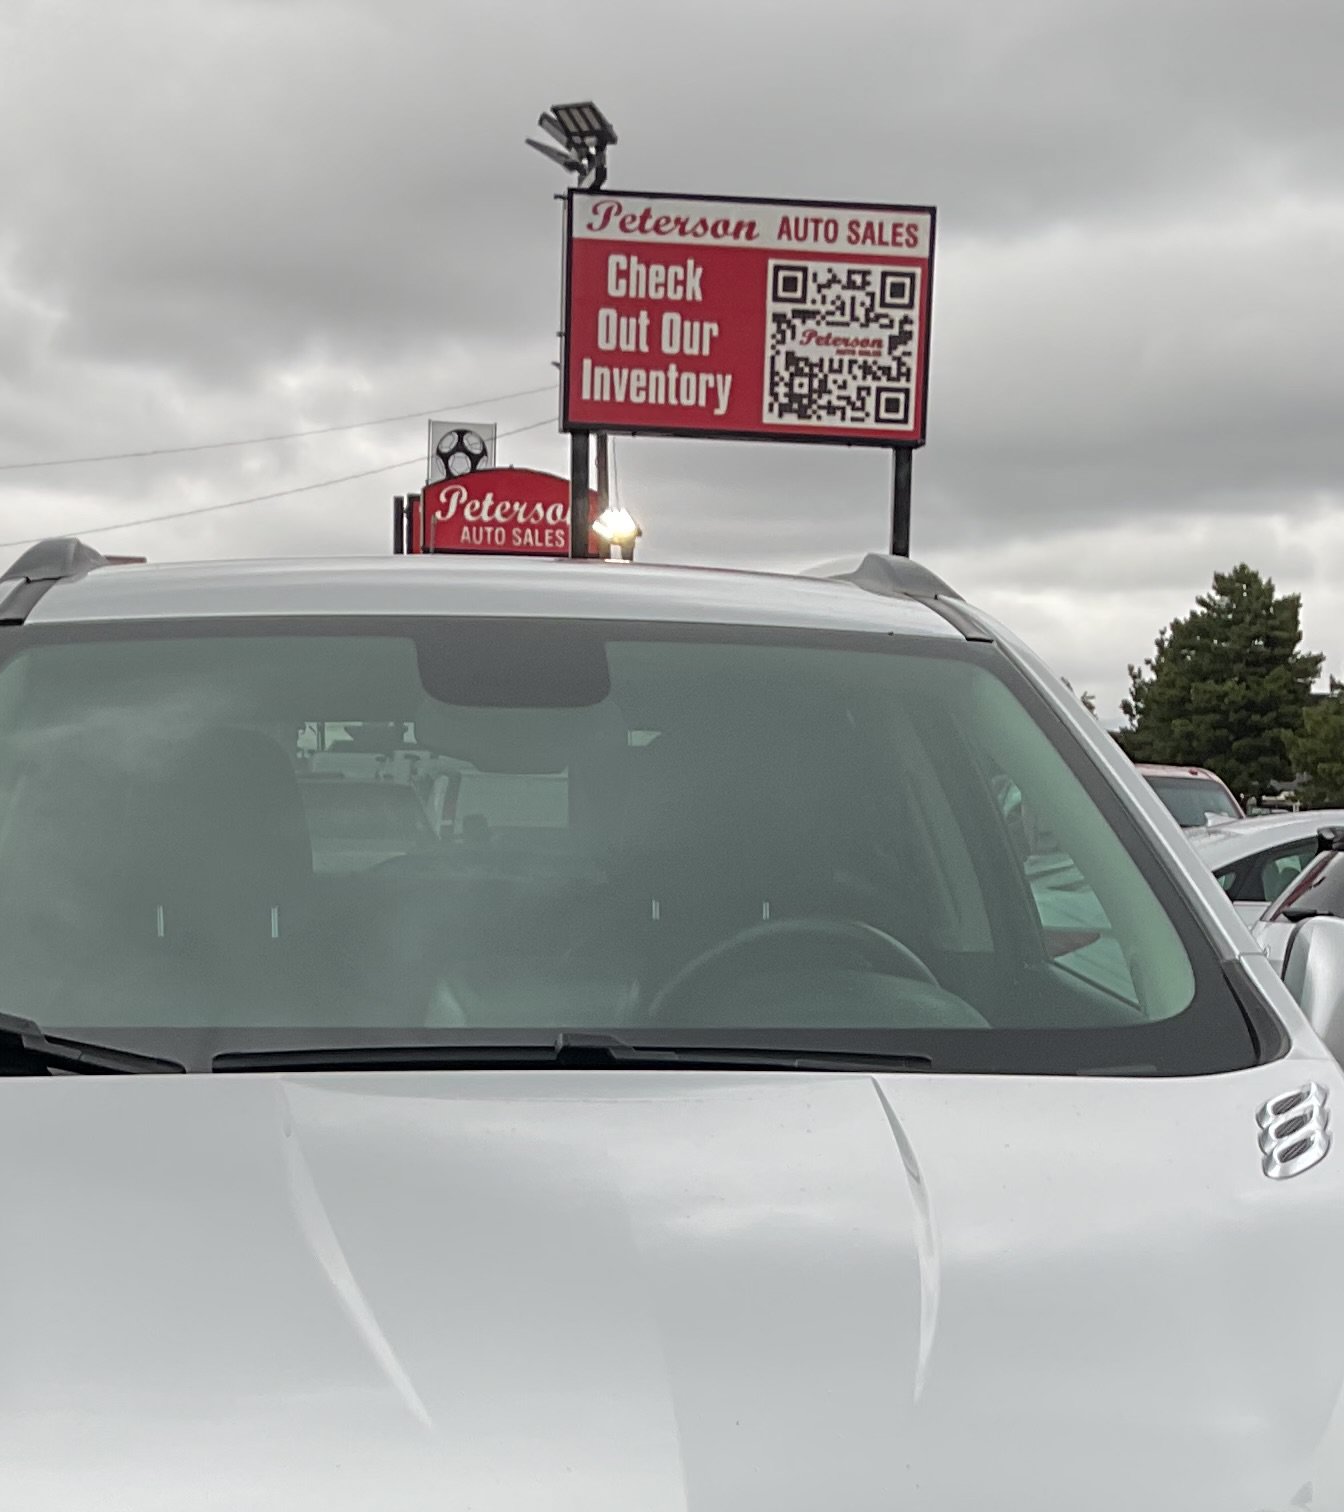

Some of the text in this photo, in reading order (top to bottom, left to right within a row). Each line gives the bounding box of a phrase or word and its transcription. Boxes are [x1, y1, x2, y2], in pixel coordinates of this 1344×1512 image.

[586, 200, 919, 248] Peterson AUTO SALES
[607, 254, 703, 302] Check
[597, 308, 719, 356] Out Our
[582, 358, 732, 416] Inventory
[436, 485, 571, 525] Peterso
[460, 526, 565, 548] AUTO SALES
